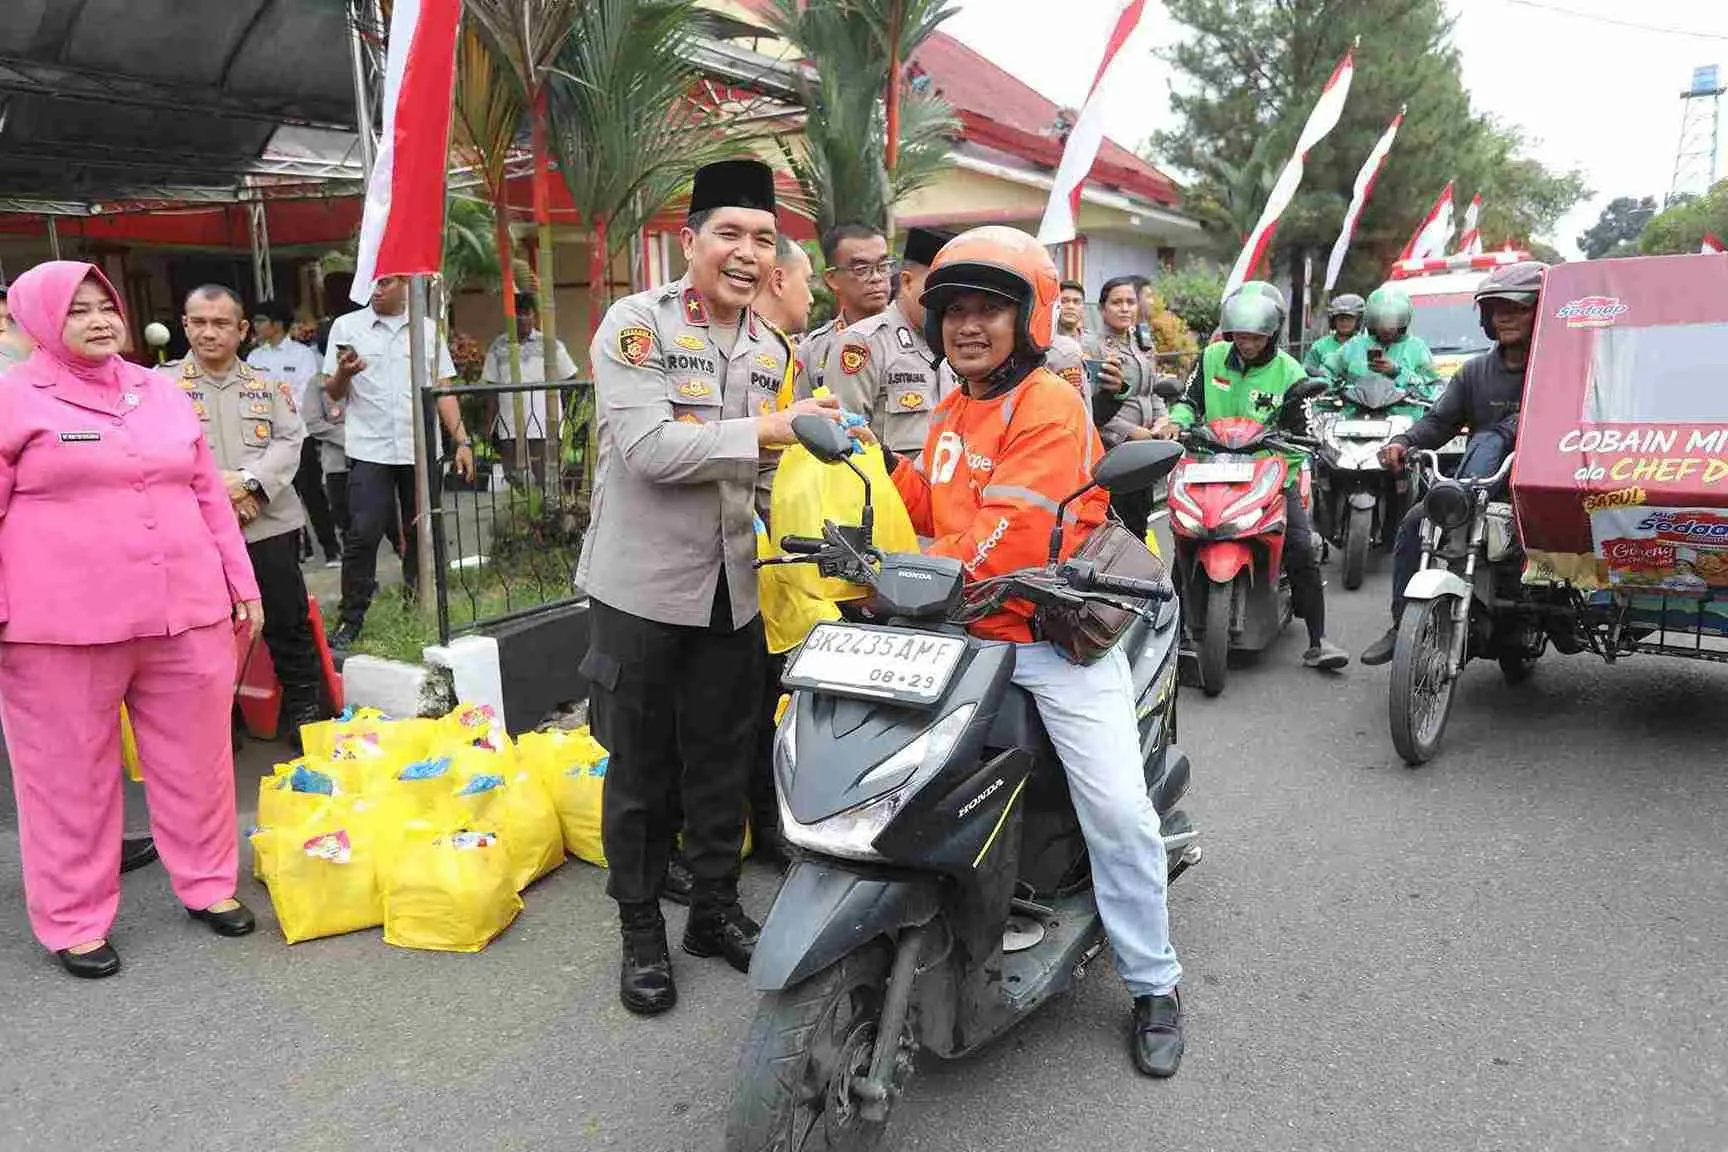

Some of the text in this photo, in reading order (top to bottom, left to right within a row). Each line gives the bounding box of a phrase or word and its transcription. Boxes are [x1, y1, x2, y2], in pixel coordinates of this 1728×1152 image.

[1558, 429, 1678, 453] COBAIN
[1574, 462, 1606, 481] ala
[1610, 457, 1700, 482] CHEF
[1635, 518, 1728, 537] Sedaa
[898, 570, 933, 581] HONDA
[958, 778, 1005, 819] HONDA
